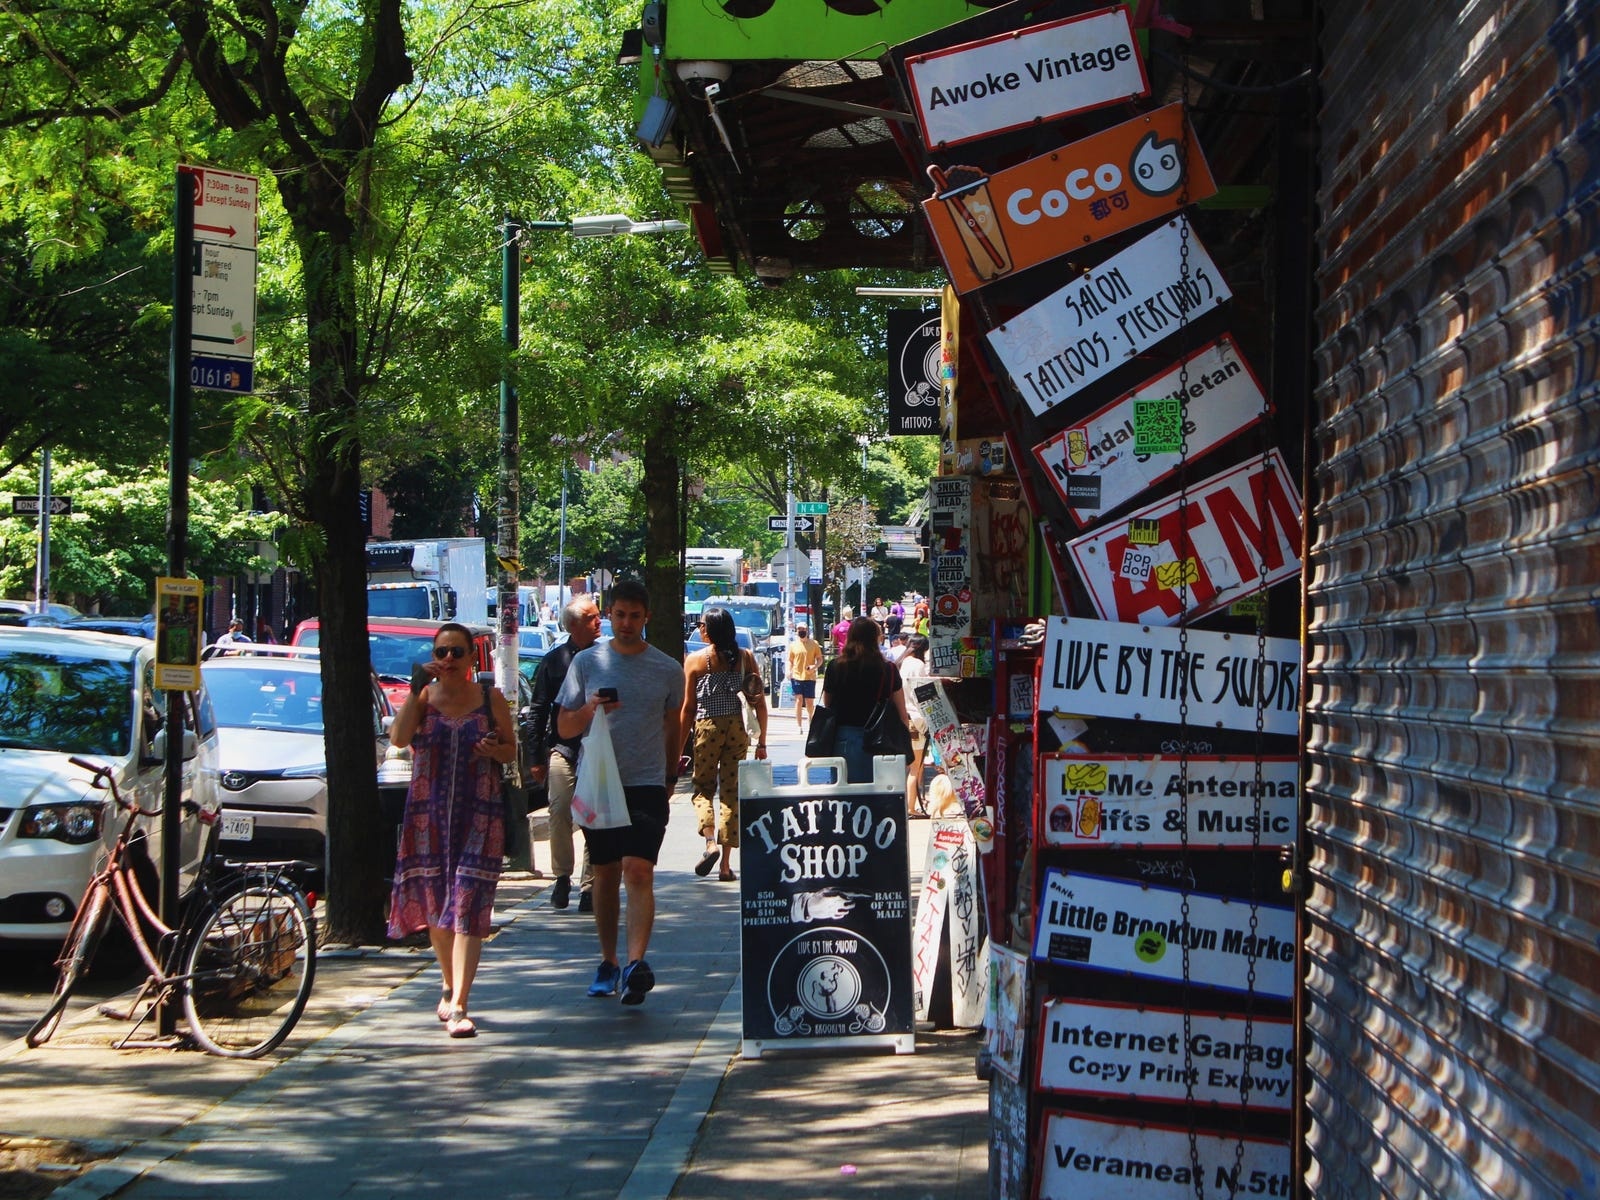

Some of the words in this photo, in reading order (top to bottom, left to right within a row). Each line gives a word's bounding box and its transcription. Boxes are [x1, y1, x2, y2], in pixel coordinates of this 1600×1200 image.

[930, 72, 1021, 110] Awoke
[1025, 43, 1132, 84] Vintage
[235, 184, 249, 195] 8am
[205, 193, 228, 206] Except
[228, 196, 251, 211] Sunday
[1089, 191, 1130, 221] 都可
[203, 290, 219, 302] 7pm
[1065, 267, 1133, 327] SALON
[206, 304, 234, 320] Sunday
[1024, 331, 1109, 402] TATTOOS
[901, 416, 933, 429] TATTOOS
[937, 482, 961, 492] SNKR
[20, 501, 38, 509] ONE
[801, 504, 807, 513] N
[809, 504, 815, 512] 4
[938, 497, 961, 507] HEAD
[1105, 466, 1301, 624] ATM
[939, 556, 962, 566] SNKR
[1123, 551, 1151, 565] pop
[939, 571, 963, 581] HEAD
[1121, 562, 1151, 577] dod
[1052, 639, 1108, 693] LIVE
[1115, 645, 1153, 697] BY
[1160, 649, 1205, 703] THE
[1212, 656, 1299, 713] SWOR
[1164, 774, 1296, 798] Antenna
[747, 800, 897, 854] TATTOO
[1100, 808, 1151, 832] ifts
[1163, 808, 1184, 832] &
[1197, 810, 1290, 832] Music
[780, 843, 868, 883] SHOP
[757, 891, 775, 900] $50
[874, 891, 902, 901] BACK
[744, 899, 787, 909] TATTOOS
[870, 901, 886, 910] OF
[886, 900, 908, 909] THE
[743, 916, 790, 926] PIERCING
[876, 910, 904, 919] MALL
[1048, 901, 1108, 933] Little
[1112, 910, 1218, 950] Brooklyn
[798, 940, 811, 955] LIVE
[812, 941, 821, 954] BY
[822, 940, 834, 954] THE
[835, 940, 858, 954] SWORD
[1051, 1020, 1180, 1055] Internet
[1068, 1055, 1132, 1082] Copy
[1139, 1063, 1199, 1086] Print
